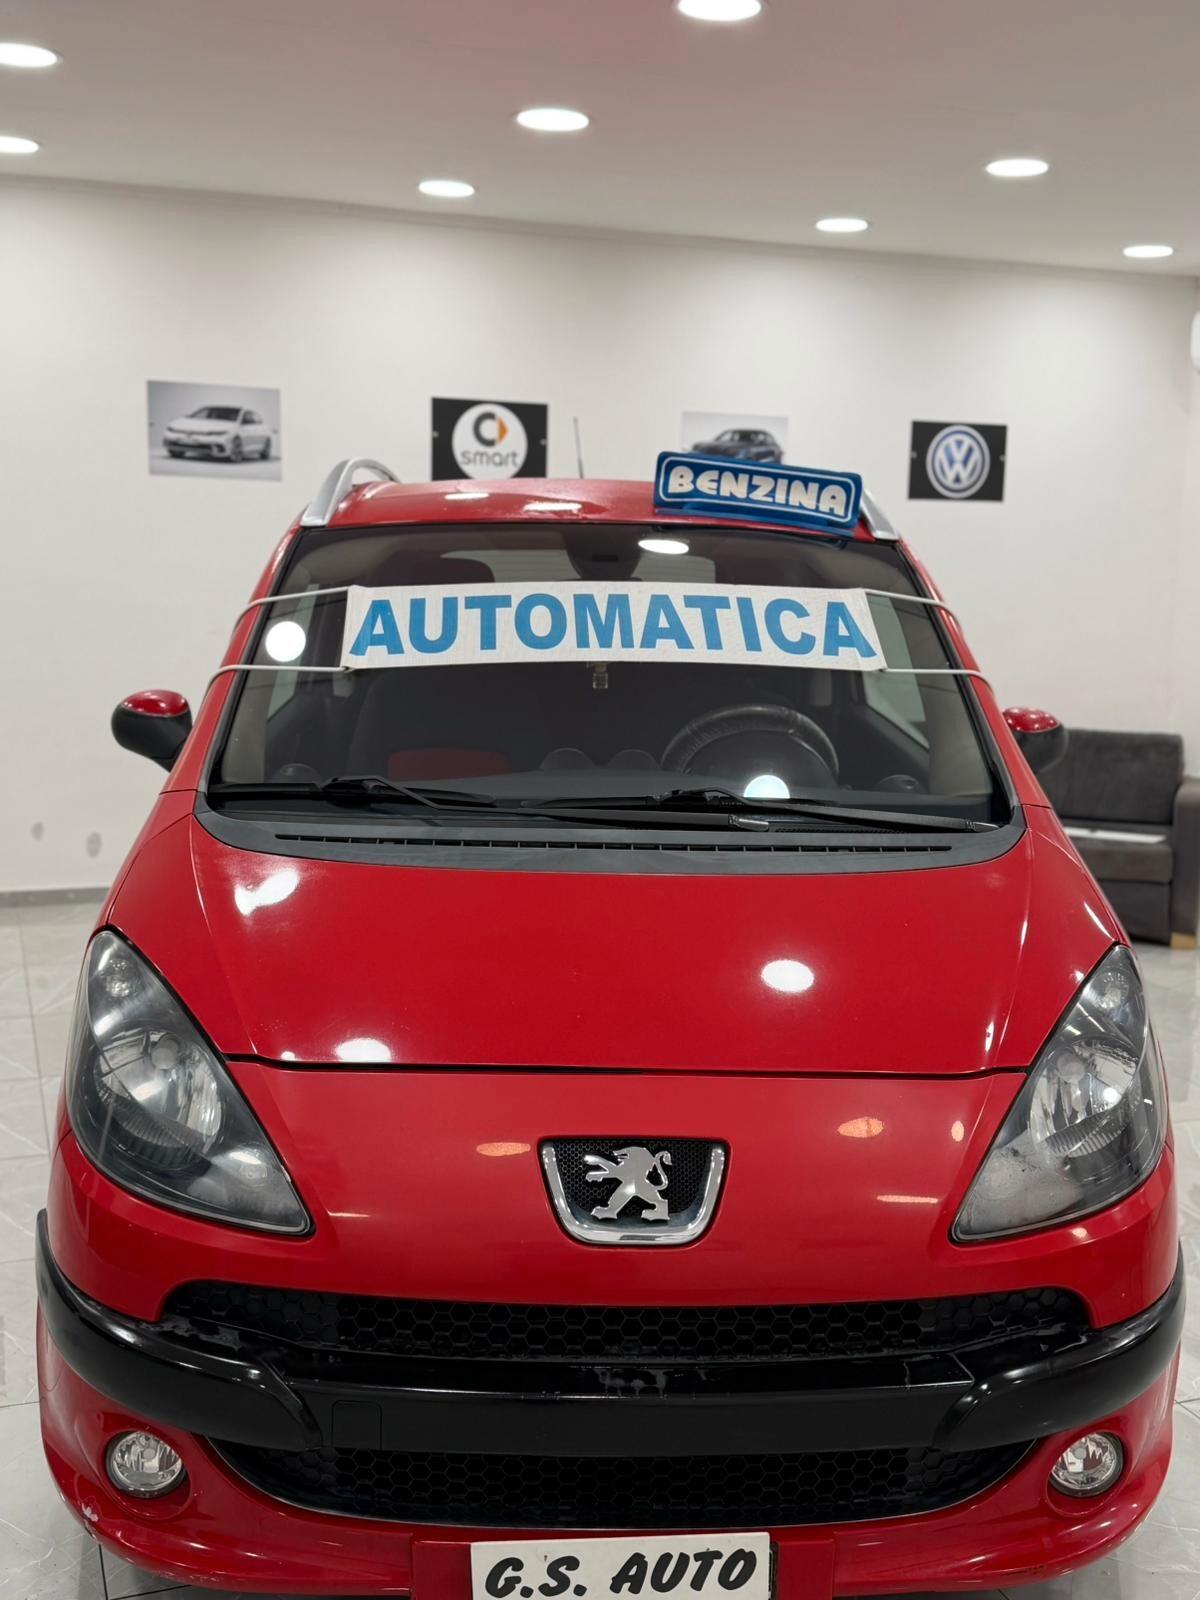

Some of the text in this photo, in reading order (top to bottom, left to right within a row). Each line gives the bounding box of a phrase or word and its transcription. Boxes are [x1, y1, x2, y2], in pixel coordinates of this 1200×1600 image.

[460, 450, 520, 468] smart
[667, 465, 849, 517] BENZINA
[349, 593, 877, 658] AUTOMATICA
[485, 1548, 758, 1599] G.S. AUTO
